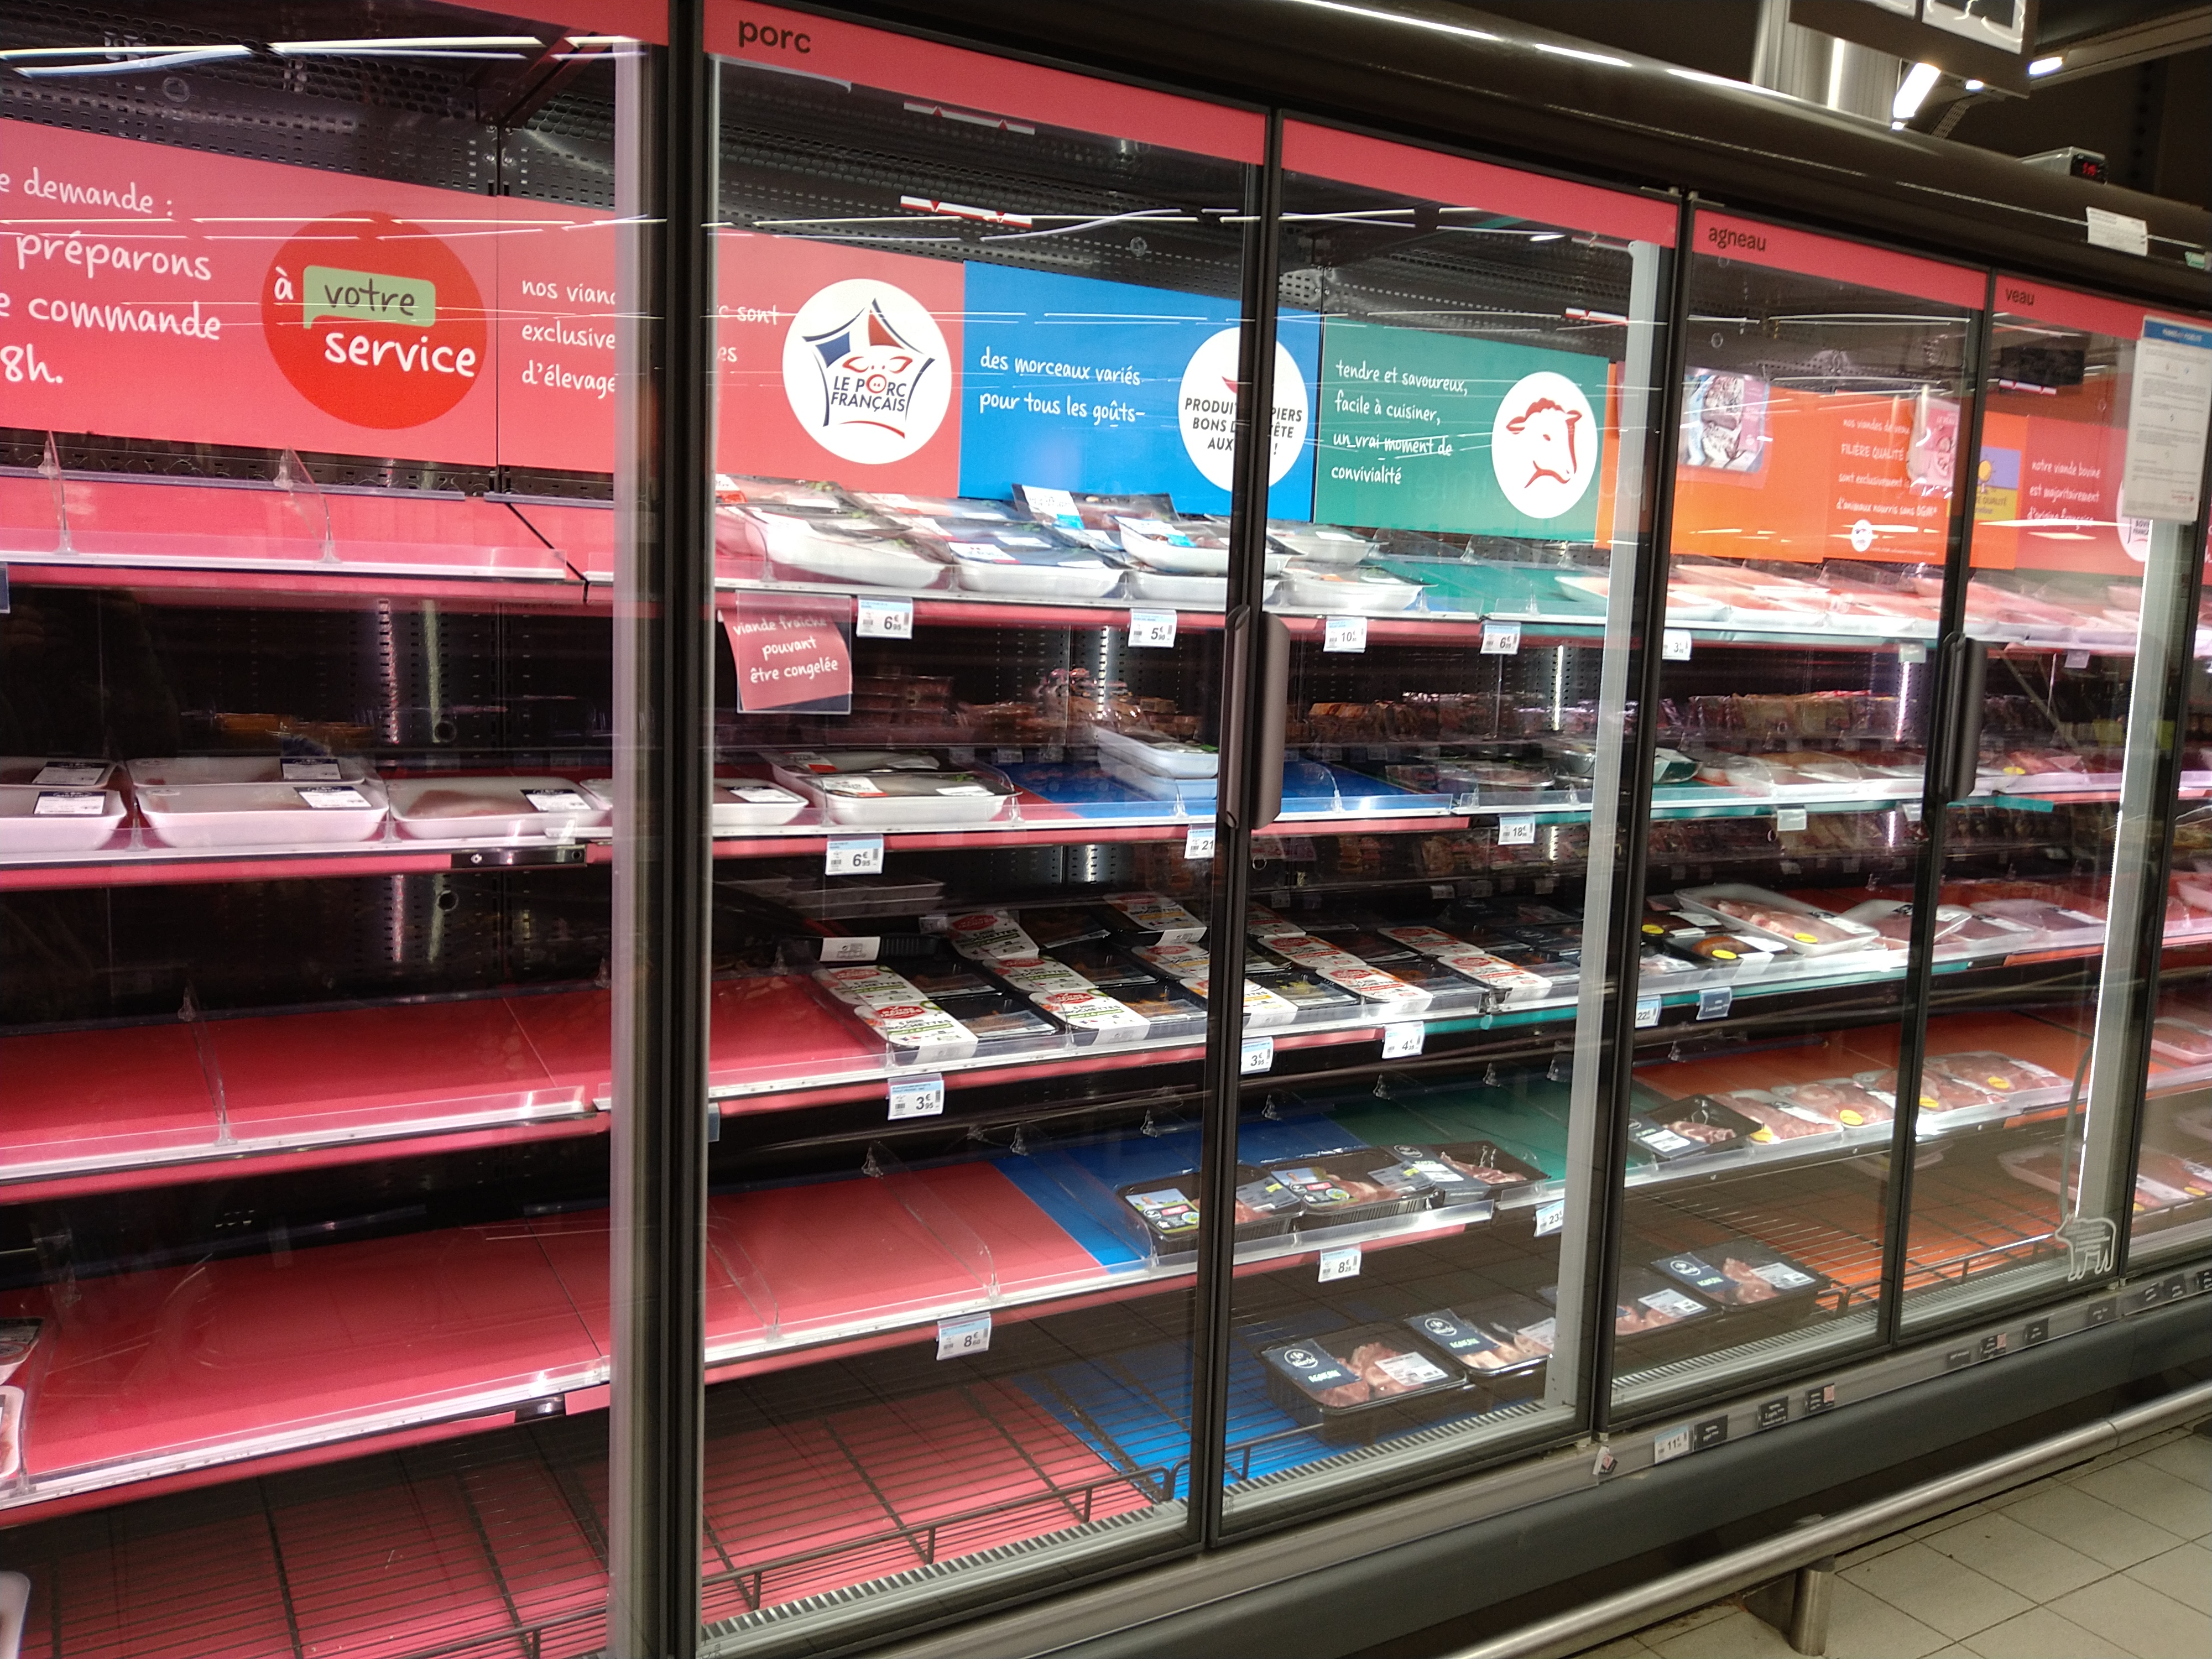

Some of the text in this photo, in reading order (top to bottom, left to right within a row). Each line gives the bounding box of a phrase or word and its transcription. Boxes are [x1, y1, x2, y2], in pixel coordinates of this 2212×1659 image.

[739, 20, 811, 54] porc
[24, 167, 153, 214] demande
[1709, 226, 1766, 252] agneau
[16, 231, 212, 280] préparons
[274, 267, 416, 316] à votre
[521, 280, 557, 299] nos
[737, 304, 778, 325] sont
[2005, 288, 2035, 306] veau
[28, 296, 220, 341] commande
[325, 315, 476, 378] service
[980, 346, 1141, 386] des morceaux variés
[1335, 359, 1468, 397] tendre et savoureux,
[833, 375, 851, 392] LE
[831, 392, 907, 413] FRANÇAIS
[979, 392, 1018, 414] pour
[1024, 392, 1061, 415] tous
[1066, 395, 1088, 418] les
[1185, 397, 1237, 415] PRODUI
[1334, 390, 1441, 426] facile à cuisiner,
[1192, 417, 1227, 432] BONS
[1271, 421, 1294, 439] ÊTE
[1843, 418, 1855, 429] nos
[1857, 418, 1882, 432] viandes
[1207, 437, 1234, 451] AUX
[1333, 431, 1453, 457] un vrai moment de
[1841, 442, 1904, 461] FILIÈRE QUALITÉ
[1332, 463, 1402, 486] convivialité
[1838, 473, 1854, 483] sont
[1855, 474, 1902, 488] exclusivement
[2031, 458, 2101, 478] notre viande bovine
[2029, 483, 2100, 503] est majoritairement
[733, 614, 828, 636] viande fraîche
[761, 636, 816, 661] pouvant
[750, 656, 838, 684] être congelée
